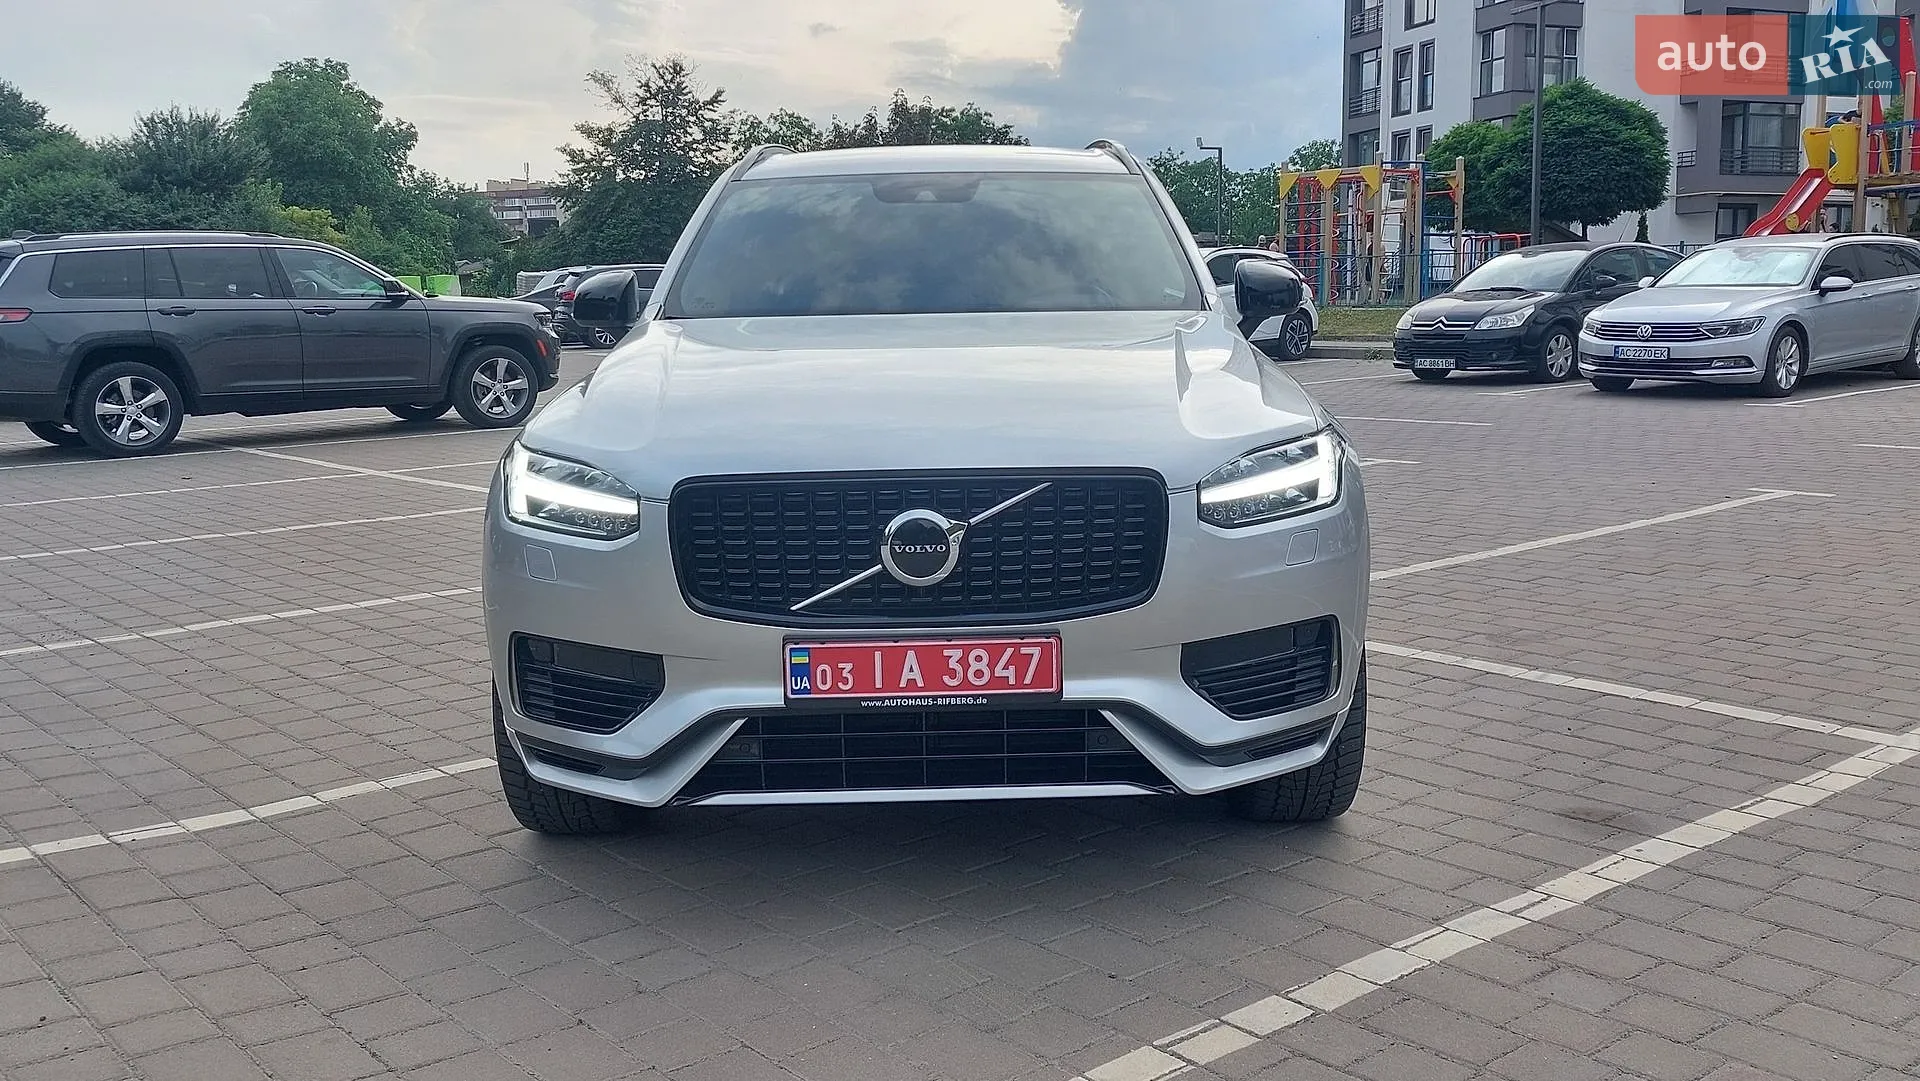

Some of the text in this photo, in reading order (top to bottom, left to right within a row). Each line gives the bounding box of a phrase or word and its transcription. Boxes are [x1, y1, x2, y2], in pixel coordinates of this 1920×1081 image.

[1620, 348, 1667, 358] AC 2270 EK
[892, 544, 946, 553] VOLVO
[816, 663, 854, 691] 03
[942, 646, 1042, 687] 3847
[791, 676, 811, 690] UA
